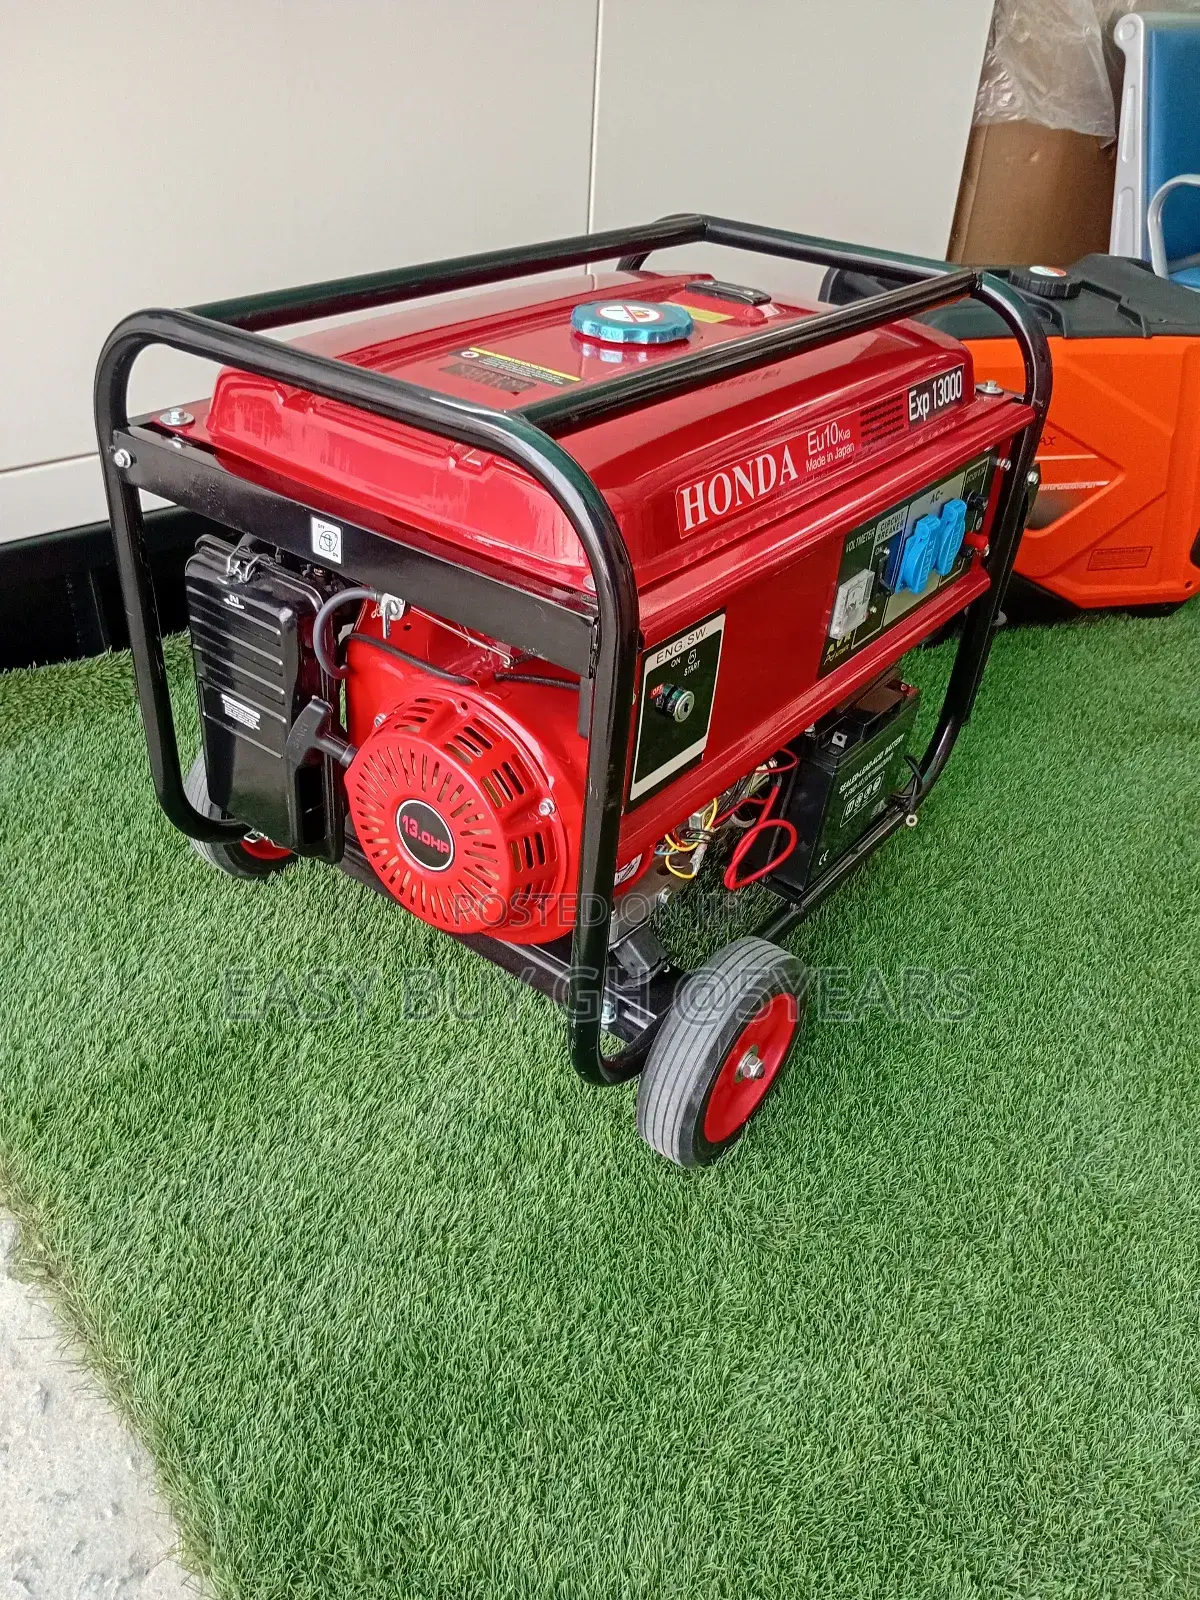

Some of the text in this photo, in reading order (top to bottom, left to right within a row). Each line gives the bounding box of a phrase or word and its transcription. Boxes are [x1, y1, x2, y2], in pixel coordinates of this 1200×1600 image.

[908, 370, 963, 422] Exp 13000
[805, 442, 855, 473] Made in Japan
[680, 444, 798, 532] HONDA
[670, 656, 681, 668] ON
[683, 660, 701, 677] START
[402, 814, 450, 854] 13.0HP
